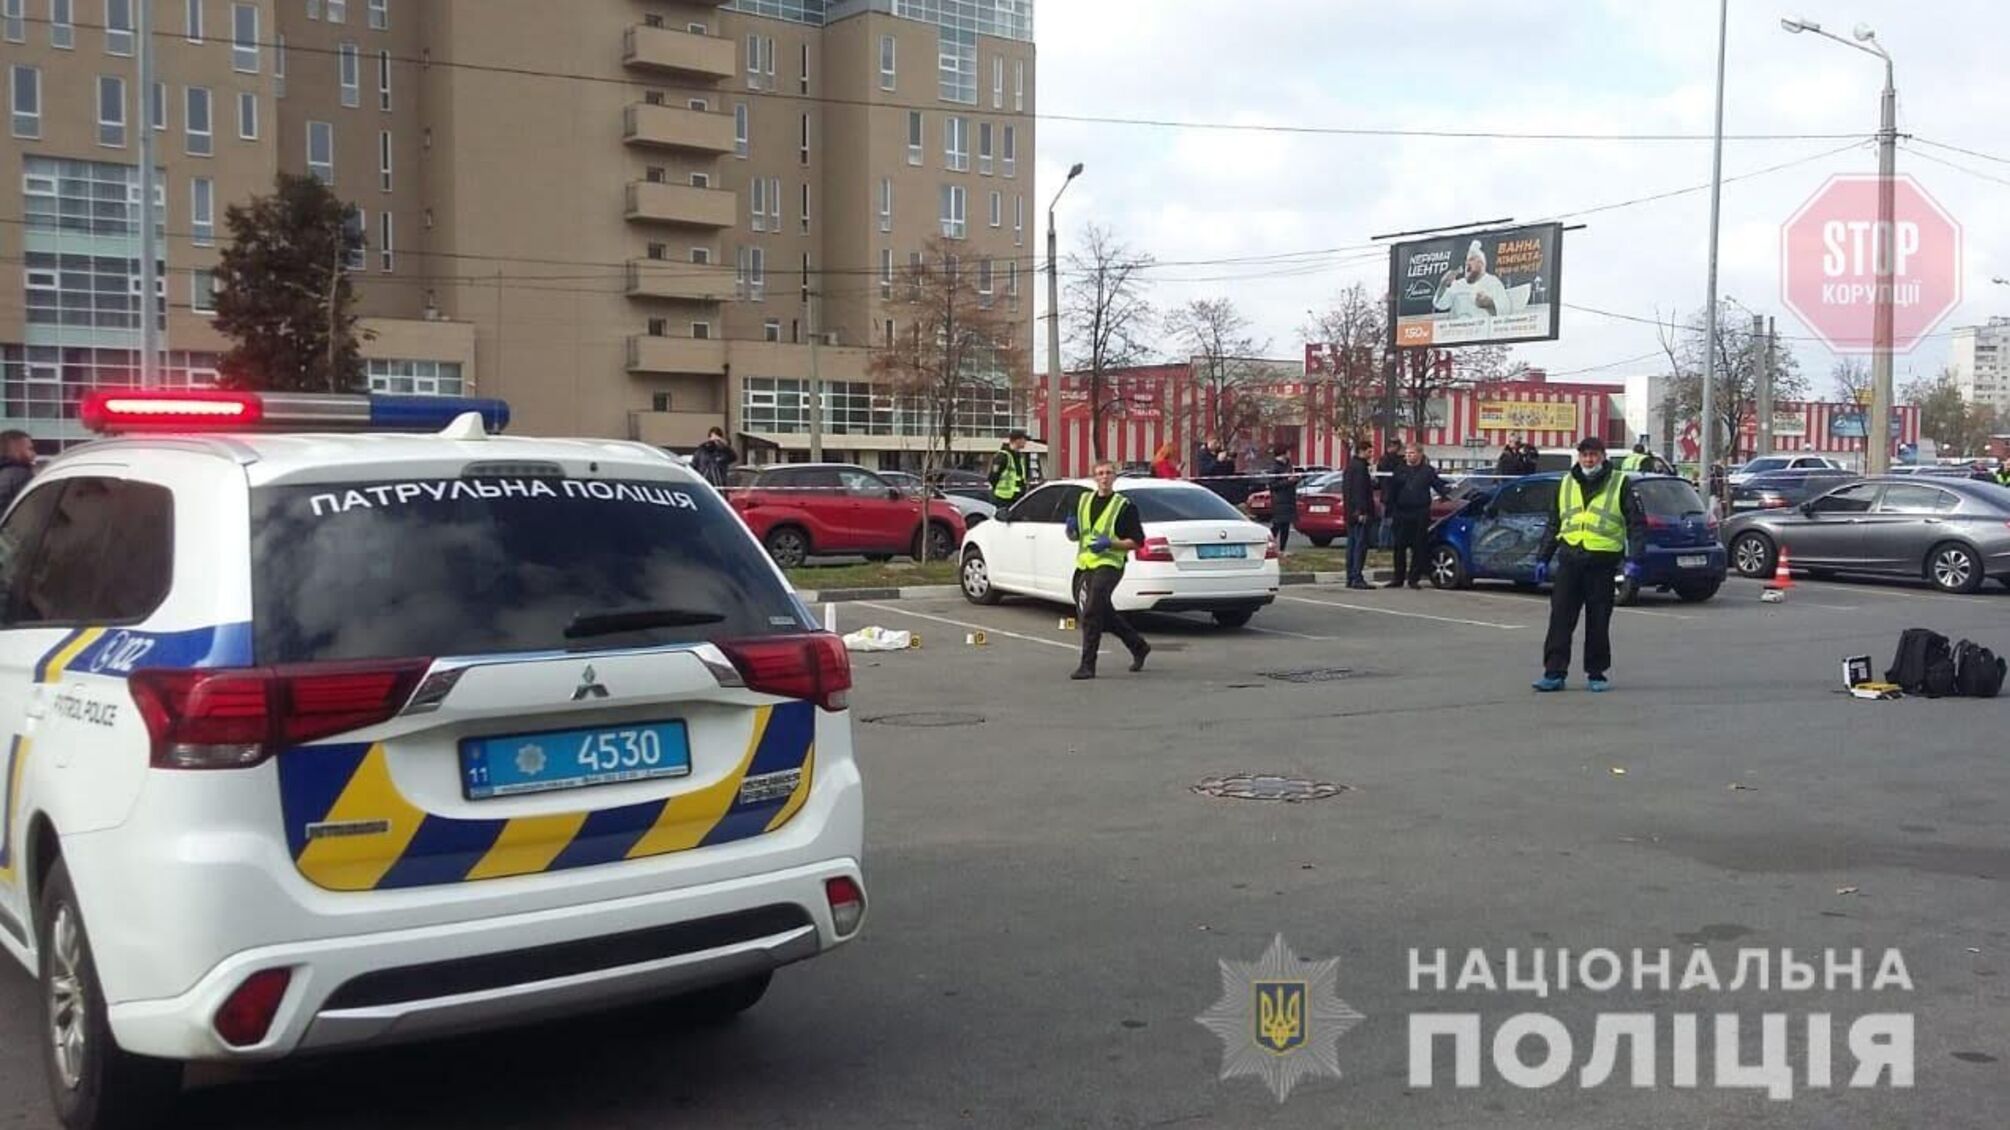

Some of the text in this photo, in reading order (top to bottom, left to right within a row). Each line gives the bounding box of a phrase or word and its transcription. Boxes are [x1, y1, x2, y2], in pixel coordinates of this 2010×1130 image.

[1497, 238, 1541, 254] ВАННА
[1407, 261, 1449, 278] ЦЕНТР
[310, 479, 699, 517] ПАТРУЛЬНА ПОЛІЦІЯ
[107, 637, 155, 672] 102
[84, 699, 118, 727] POLICE
[576, 727, 661, 771] 4530
[469, 766, 489, 784] 11
